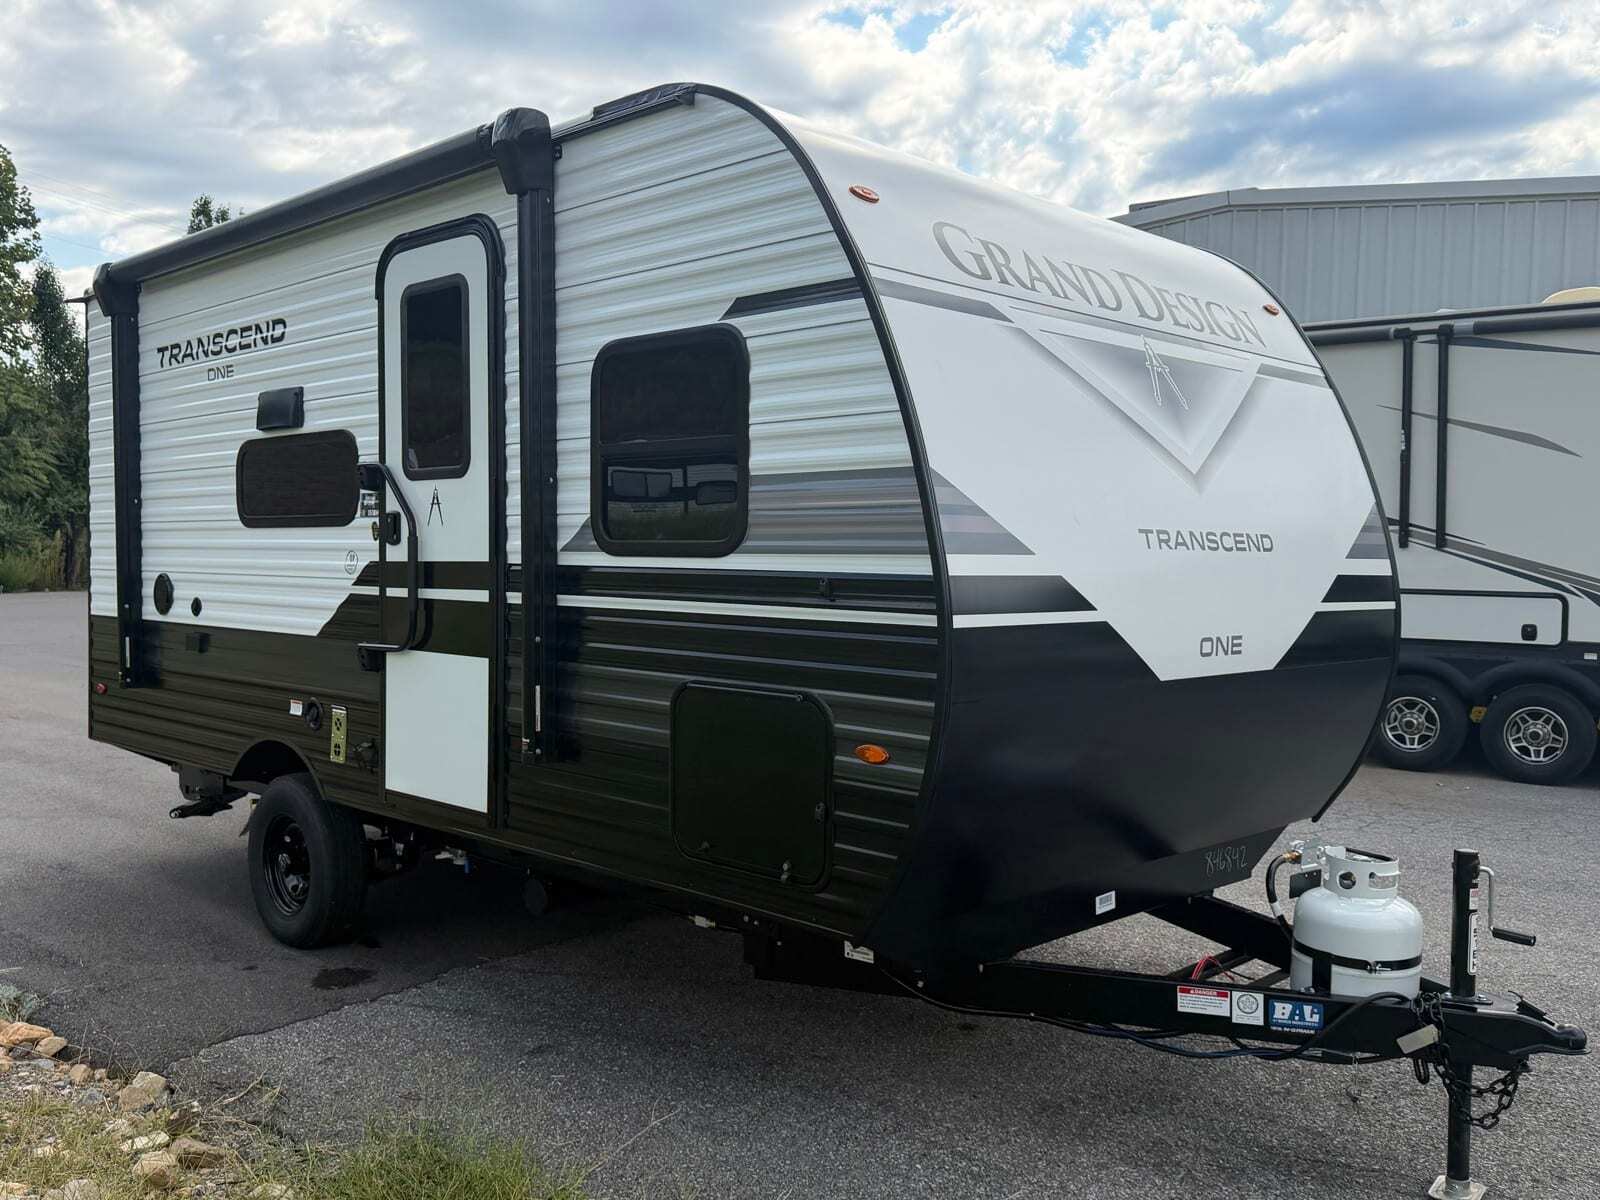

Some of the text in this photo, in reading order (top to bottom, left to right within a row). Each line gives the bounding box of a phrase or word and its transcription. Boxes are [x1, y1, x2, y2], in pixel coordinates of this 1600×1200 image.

[932, 220, 1266, 348] GRAND DESIGN
[157, 318, 287, 368] TRANSCEND
[207, 364, 235, 381] ONE
[1138, 528, 1273, 552] TRANSCEND
[1200, 635, 1242, 657] ONE
